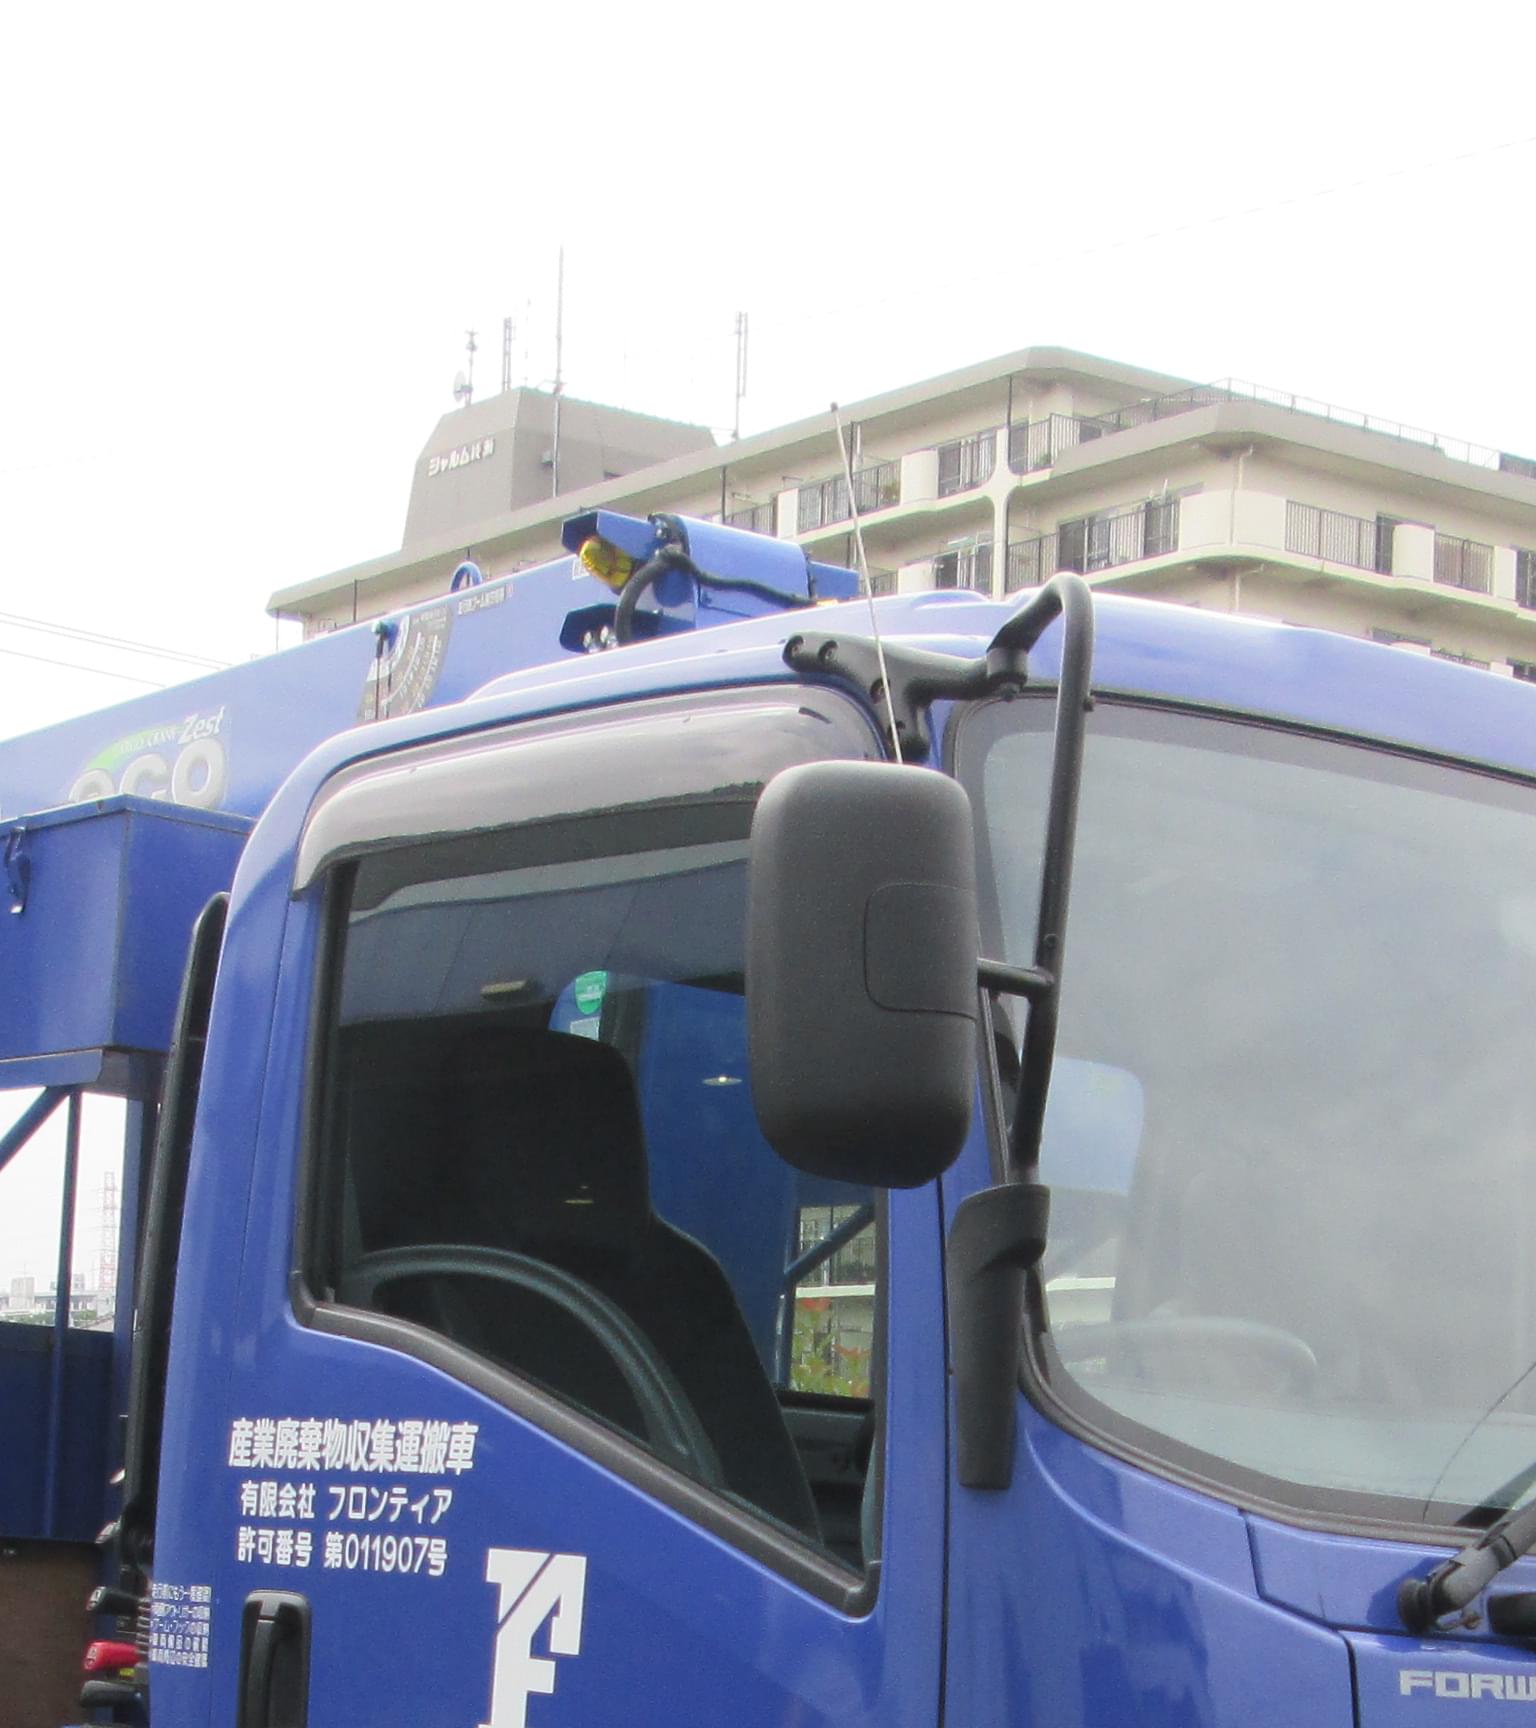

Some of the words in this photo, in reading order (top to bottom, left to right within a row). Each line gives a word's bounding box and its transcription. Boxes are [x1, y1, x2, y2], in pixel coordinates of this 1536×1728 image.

[177, 705, 225, 745] Zest
[228, 1416, 480, 1476] 産業廃棄物収集運搬車
[241, 1480, 316, 1520] 有限会社
[328, 1486, 453, 1525] フロンティア
[237, 1526, 313, 1569] 許可番号
[323, 1531, 448, 1577] 第011907号
